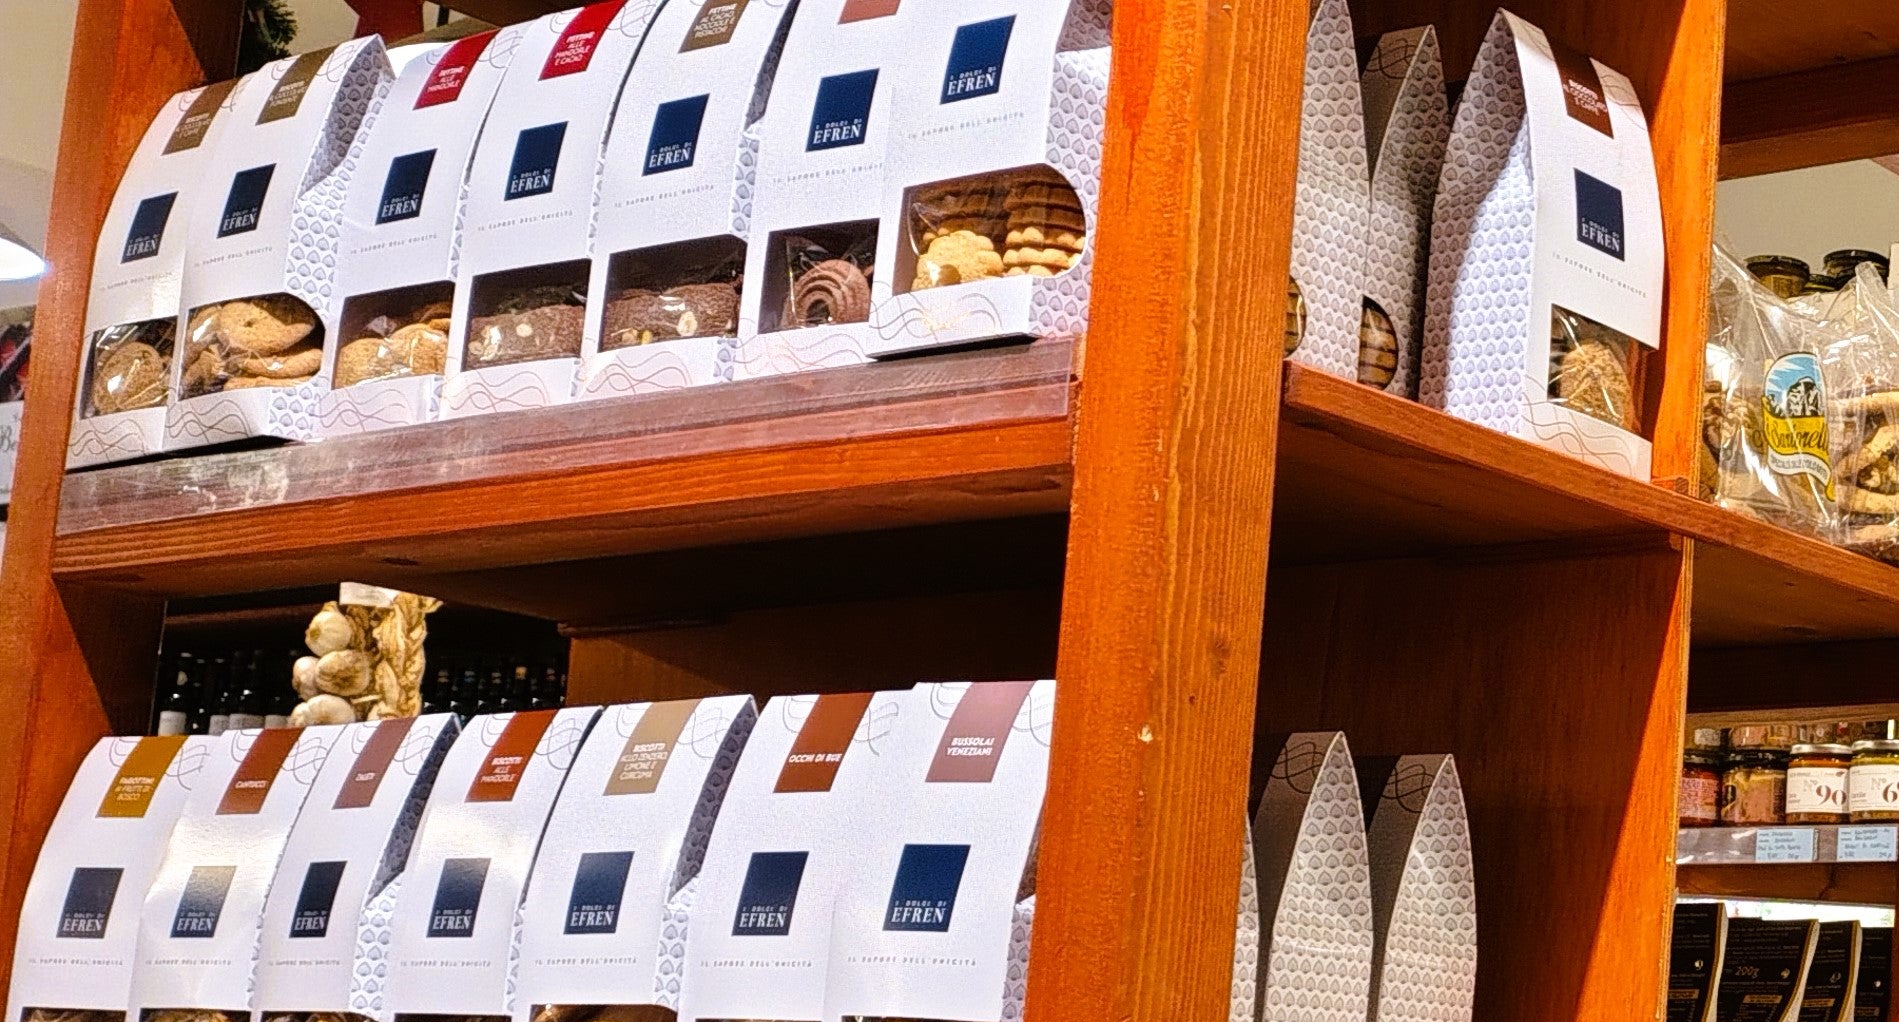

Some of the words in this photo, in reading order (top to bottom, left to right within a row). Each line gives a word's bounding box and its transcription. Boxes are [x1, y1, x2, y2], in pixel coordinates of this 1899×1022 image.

[948, 72, 995, 95] EFREN
[813, 123, 862, 144] EFREN
[649, 148, 691, 168] EFREN
[510, 174, 550, 193] EFREN
[381, 199, 420, 218] EFREN
[223, 213, 256, 231] EFREN
[1582, 223, 1620, 252] EFREN
[125, 239, 159, 257] EFREN
[952, 737, 995, 747] BUSSOLAI
[945, 746, 994, 757] VENEZIANI
[1816, 784, 1847, 805] 90
[176, 916, 214, 932] EFREN
[294, 916, 327, 931] EFREN
[432, 916, 471, 931] EFREN
[570, 910, 615, 926] EFREN
[739, 911, 786, 928] EFREN
[890, 906, 946, 924] EFREN
[62, 918, 104, 933] EFREN
